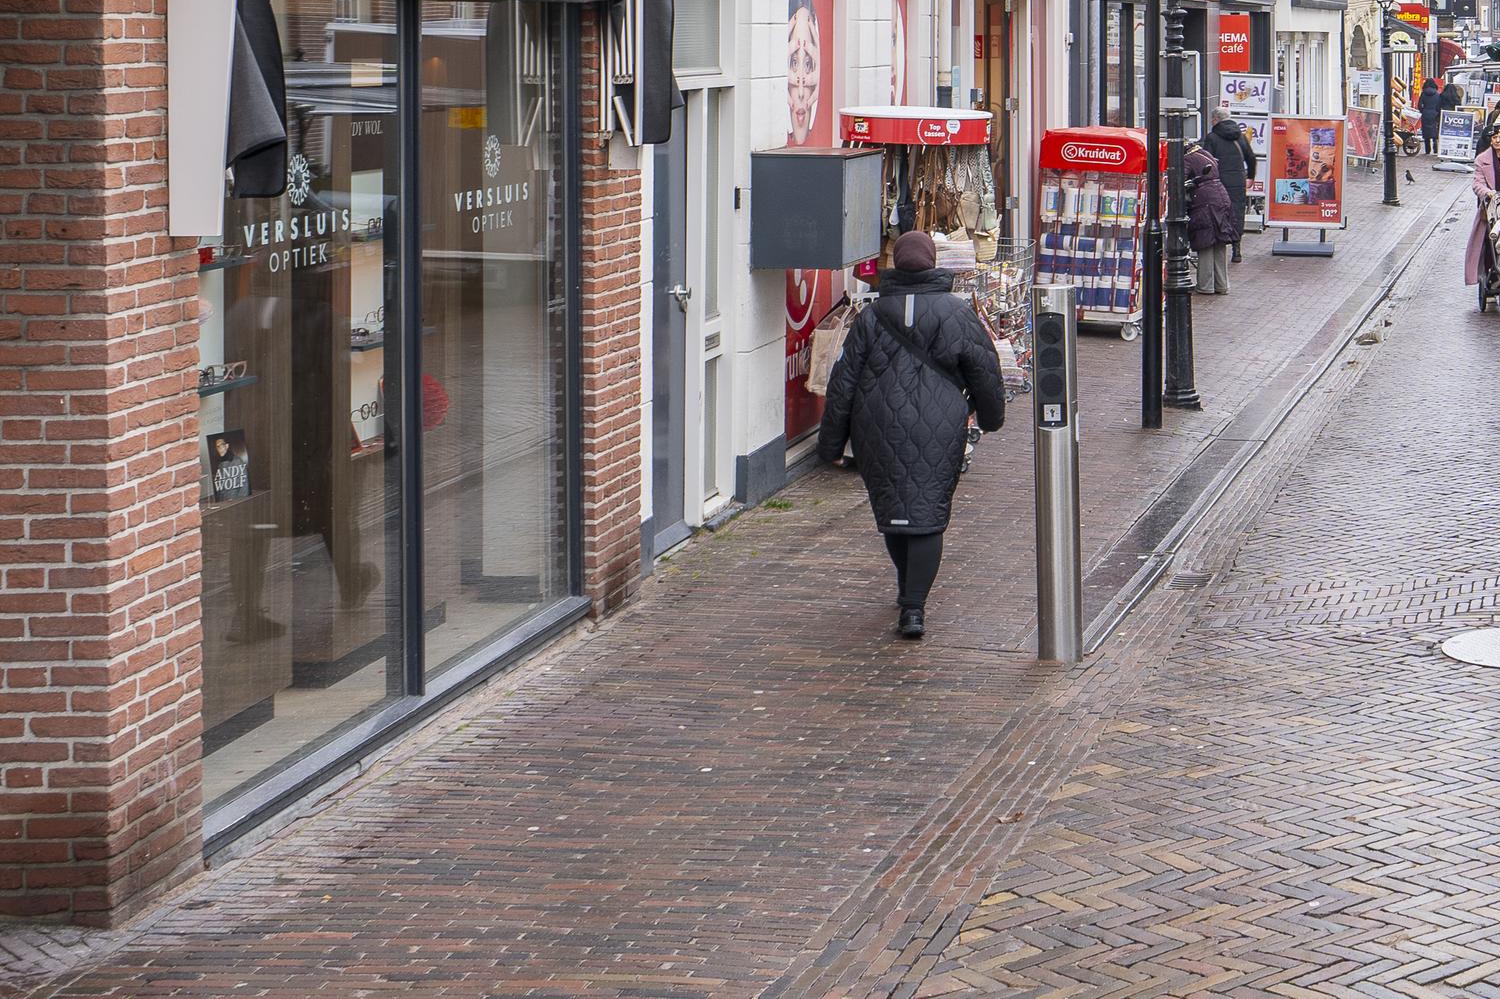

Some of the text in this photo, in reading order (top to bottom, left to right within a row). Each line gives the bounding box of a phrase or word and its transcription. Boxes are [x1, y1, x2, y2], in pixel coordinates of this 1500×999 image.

[1221, 43, 1244, 53] café
[928, 123, 941, 132] Top
[1444, 115, 1464, 125] Lyca
[1239, 122, 1265, 139] eal
[1078, 147, 1121, 161] Kruidvat
[454, 182, 529, 212] VERSLUIS
[243, 208, 350, 248] VERSLUIS
[472, 210, 513, 233] OPTIEK
[269, 242, 328, 273] OPTIEK
[214, 463, 247, 481] ANDY
[214, 474, 247, 492] WOLF
